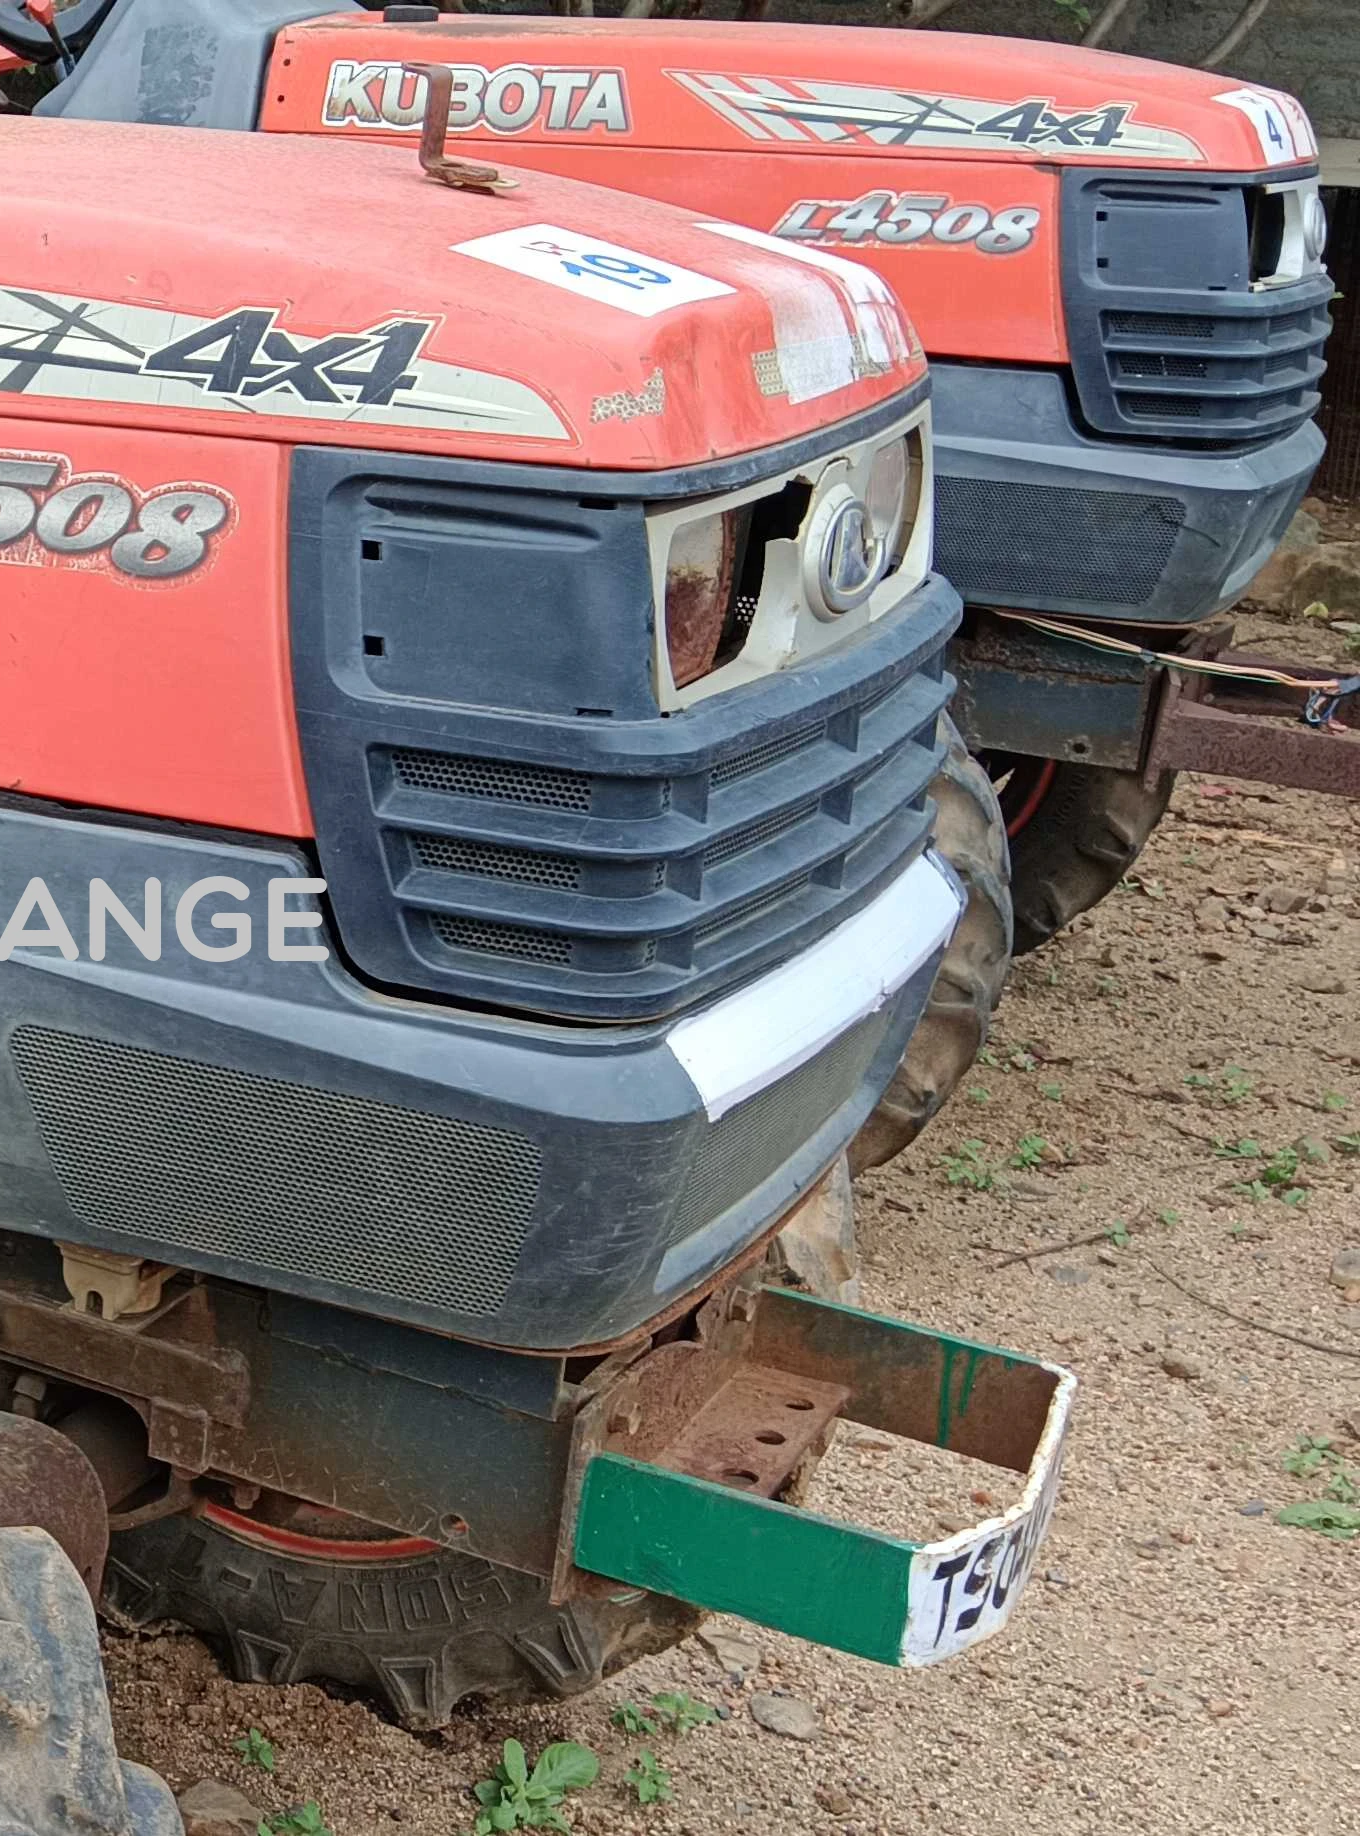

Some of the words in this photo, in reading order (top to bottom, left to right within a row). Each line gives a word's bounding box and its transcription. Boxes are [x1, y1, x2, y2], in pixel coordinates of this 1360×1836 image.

[328, 63, 630, 133] KUBOTA
[775, 192, 1041, 256] L4508
[559, 253, 673, 291] 19
